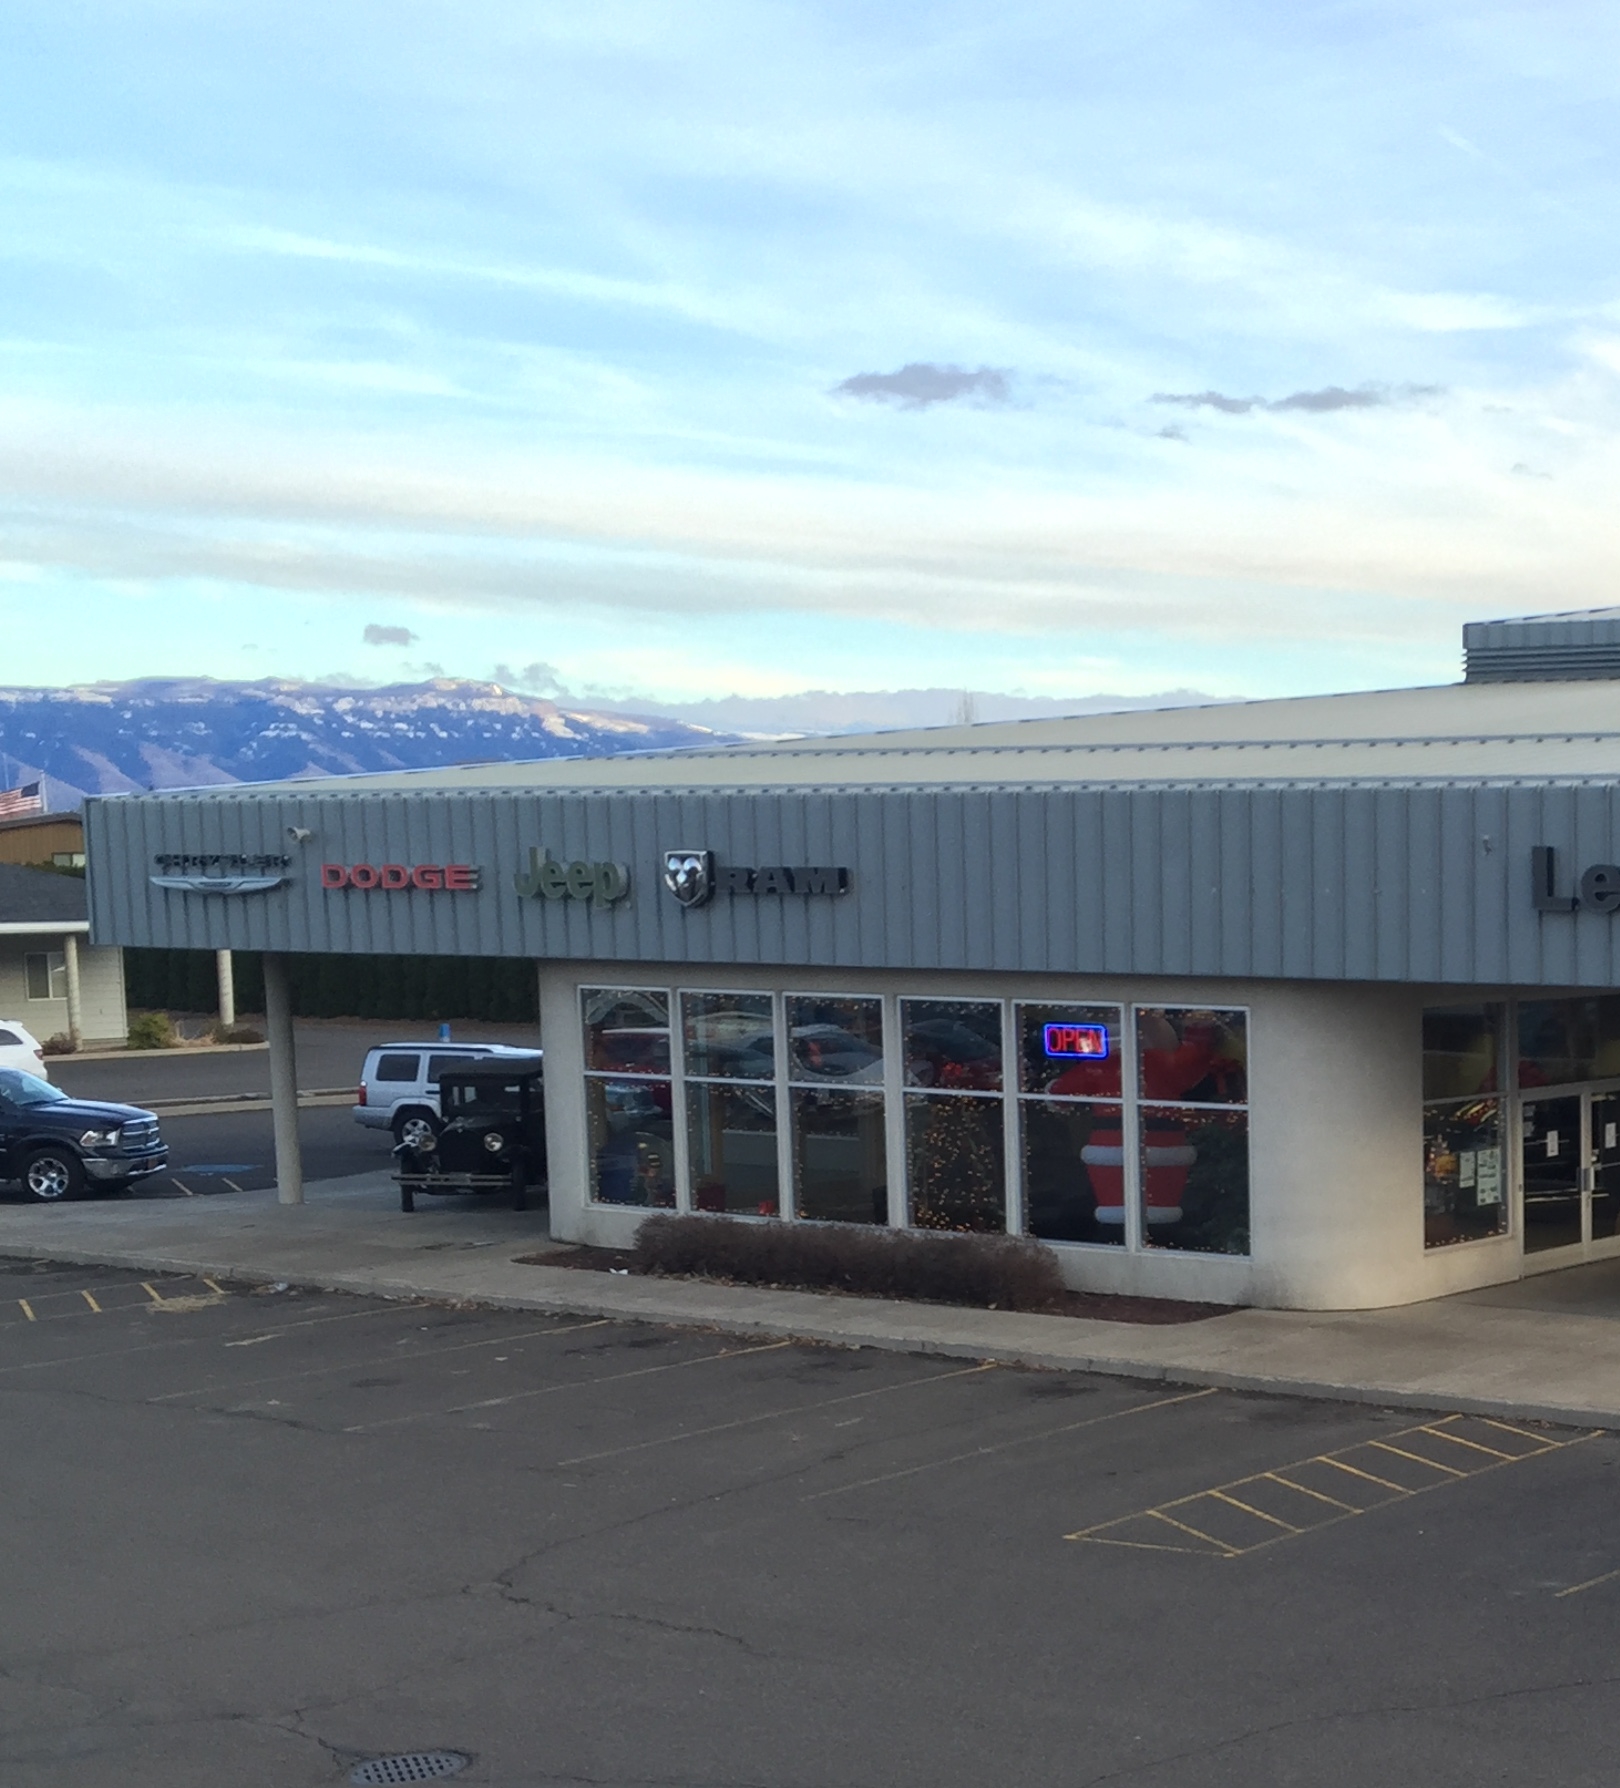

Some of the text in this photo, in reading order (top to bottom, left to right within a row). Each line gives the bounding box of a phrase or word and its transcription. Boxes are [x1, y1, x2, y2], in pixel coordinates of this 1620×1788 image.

[321, 864, 478, 889] DODGE
[514, 846, 628, 908] Jeep
[716, 866, 850, 894] RAM
[1048, 1027, 1103, 1053] OPEN
